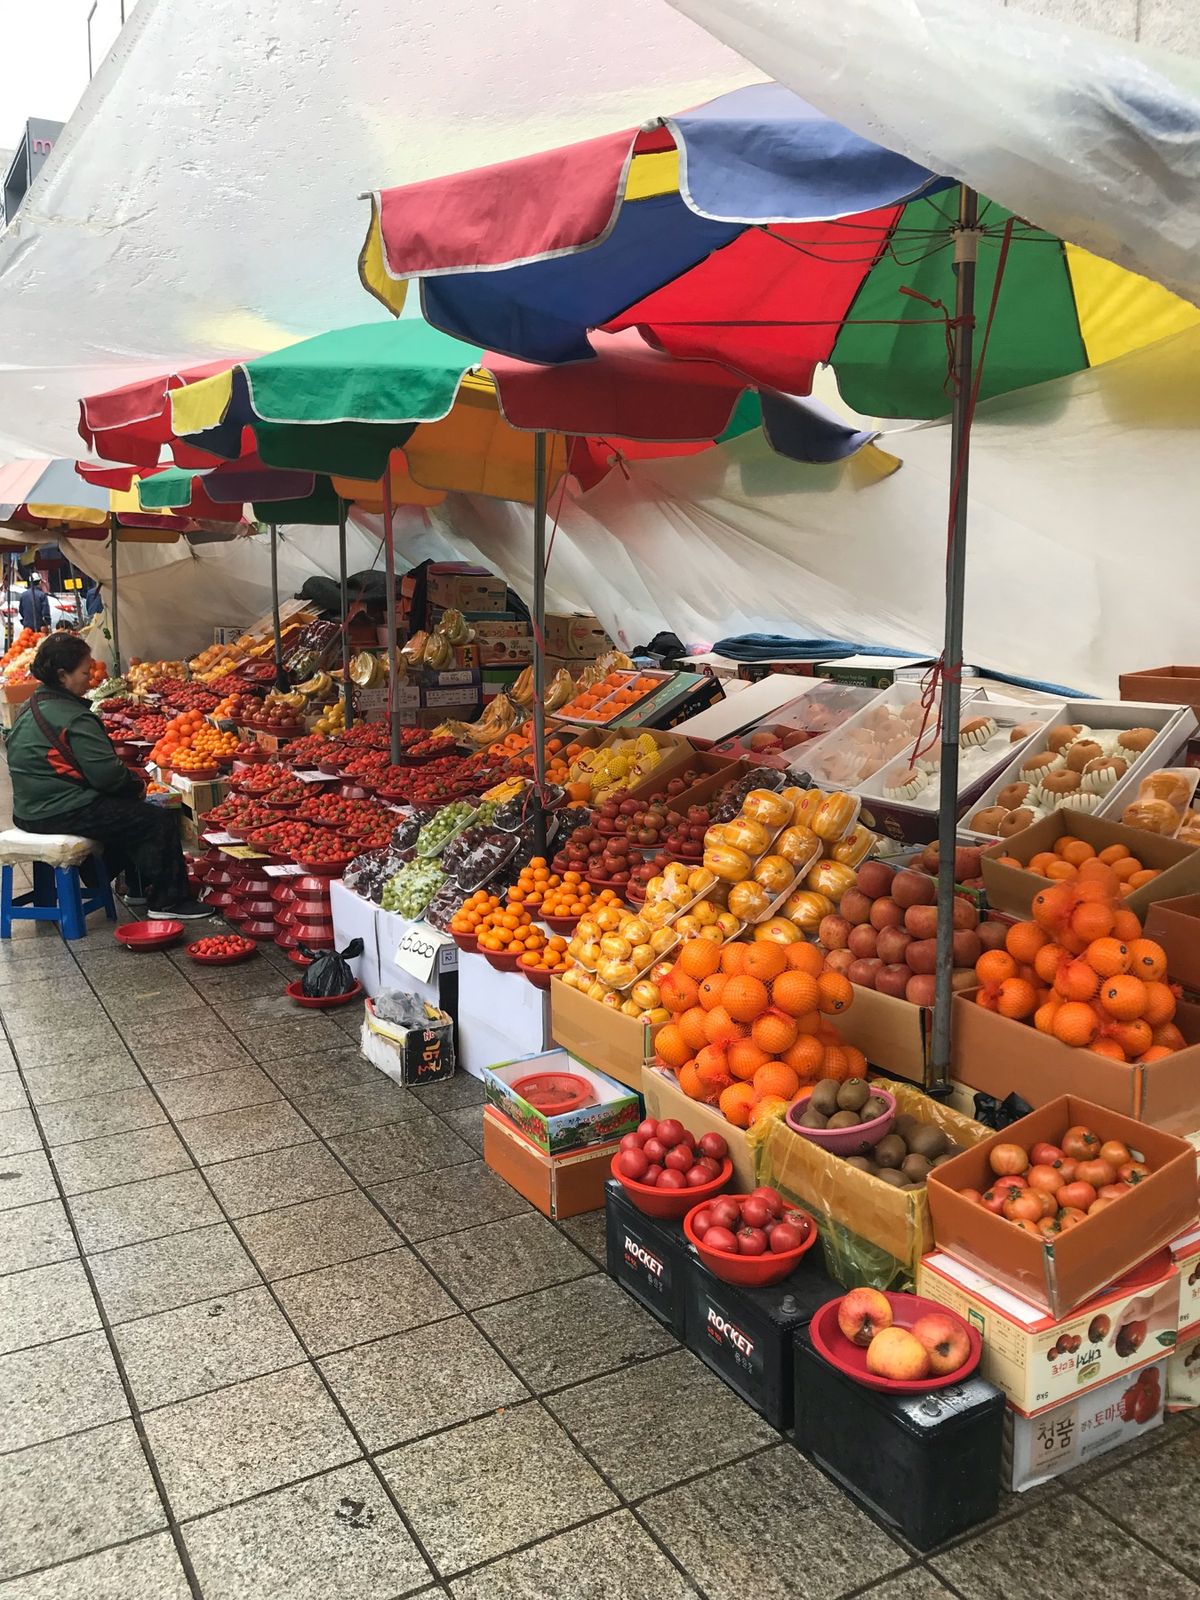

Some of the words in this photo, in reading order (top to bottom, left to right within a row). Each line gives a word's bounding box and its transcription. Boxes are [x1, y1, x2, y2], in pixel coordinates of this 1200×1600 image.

[624, 1234, 664, 1277] ROCKET
[707, 1306, 754, 1357] ROCKET
[1076, 1349, 1102, 1368] 대저
[1036, 1391, 1048, 1401] 5kg
[1094, 1399, 1127, 1429] 토마토
[1037, 1418, 1074, 1450] 청품
